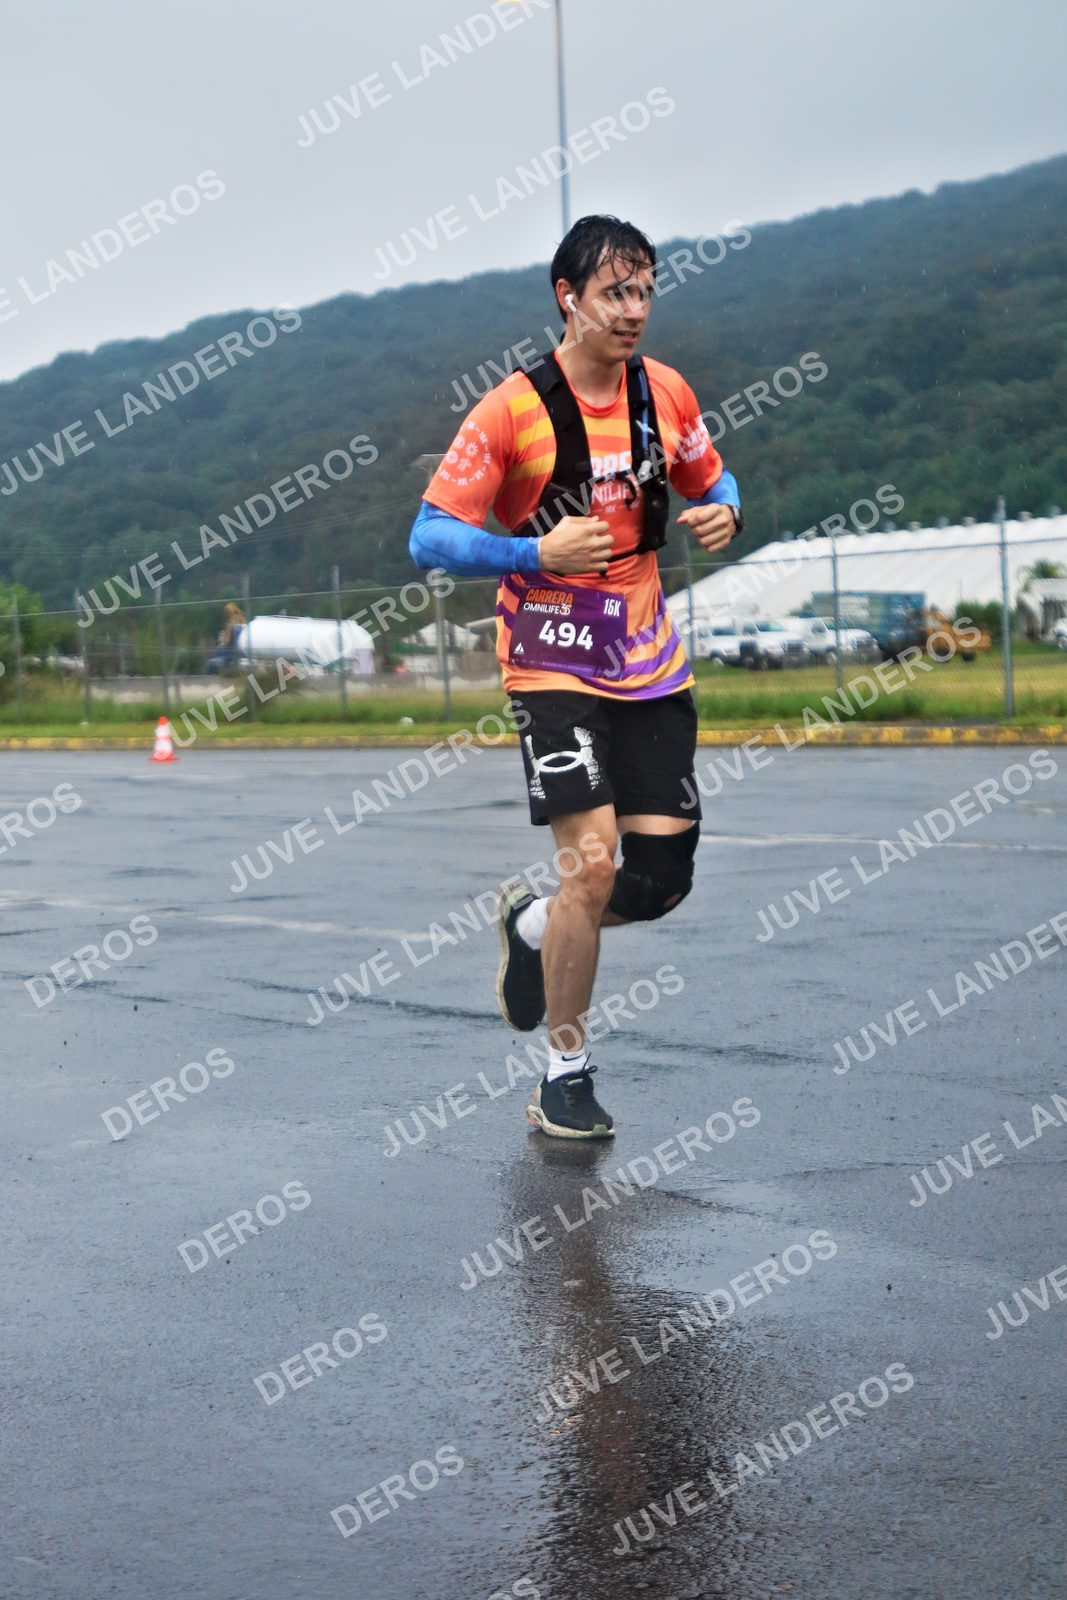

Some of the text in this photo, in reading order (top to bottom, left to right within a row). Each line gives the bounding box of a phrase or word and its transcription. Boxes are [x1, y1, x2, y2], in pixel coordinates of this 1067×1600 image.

[525, 588, 574, 606] CARRERA
[603, 598, 621, 617] 15K
[538, 620, 594, 651] 494
